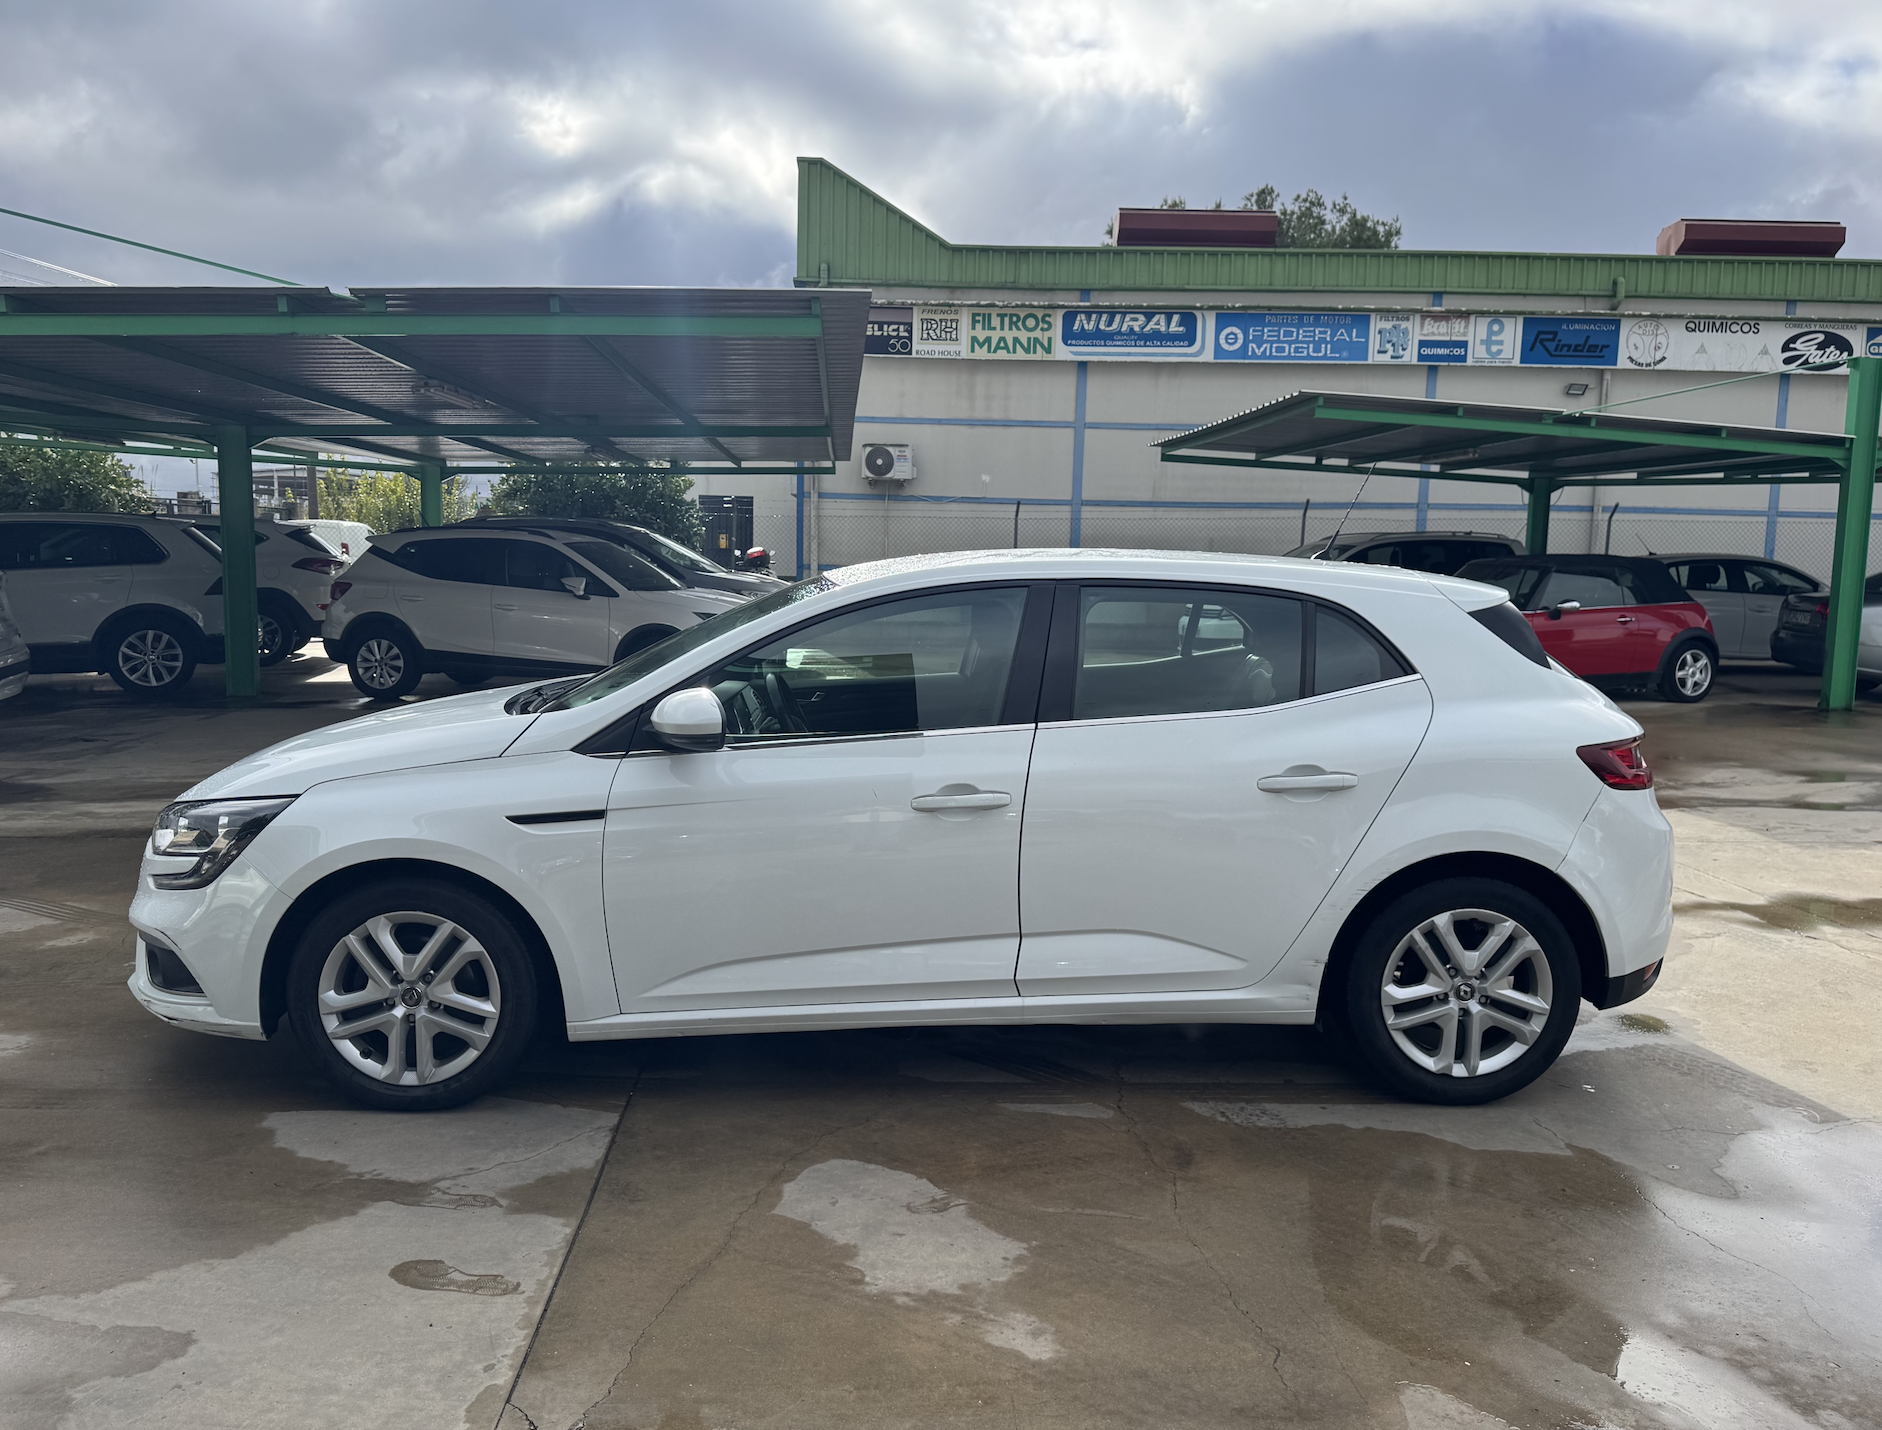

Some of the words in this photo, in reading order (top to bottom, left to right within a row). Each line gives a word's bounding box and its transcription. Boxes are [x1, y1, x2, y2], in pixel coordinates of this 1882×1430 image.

[971, 312, 1052, 332] FILTROS
[1073, 313, 1186, 333] NURAL
[1265, 315, 1298, 324] PARTES
[1304, 315, 1315, 323] DE
[1320, 316, 1352, 324] MOTOR
[866, 324, 910, 336] SLICK
[920, 318, 959, 341] RH
[1249, 327, 1366, 342] FEDERAL
[1684, 320, 1760, 335] QUIMICOS
[888, 339, 911, 352] 50
[970, 335, 1052, 355] MANN
[1248, 343, 1340, 357] MOGUL
[1420, 347, 1465, 355] QUIMICOS
[1781, 332, 1848, 368] Gates
